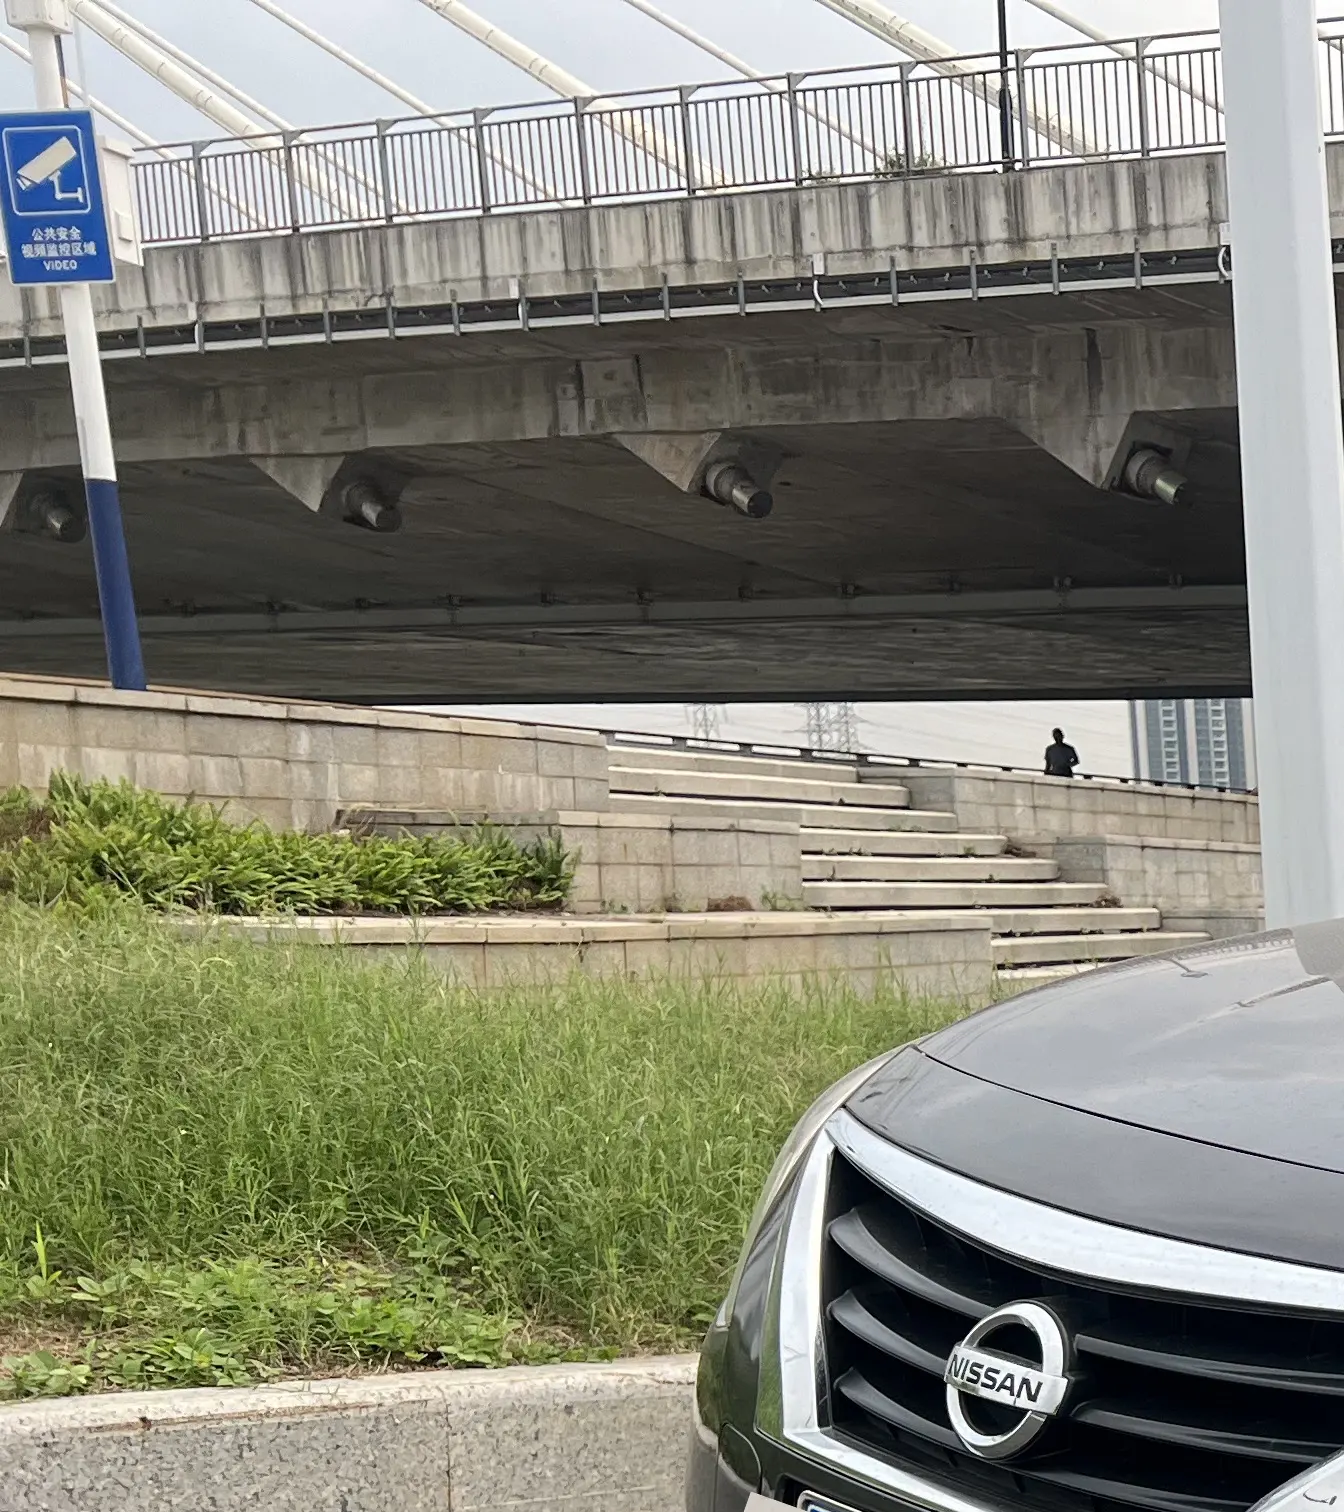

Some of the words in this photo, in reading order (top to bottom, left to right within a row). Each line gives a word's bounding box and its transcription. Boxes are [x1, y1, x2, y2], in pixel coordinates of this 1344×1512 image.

[32, 226, 81, 241] 公共安全
[21, 241, 97, 259] 视频监控区域
[43, 259, 78, 271] VIDEO
[948, 1353, 1043, 1403] NISSAN
